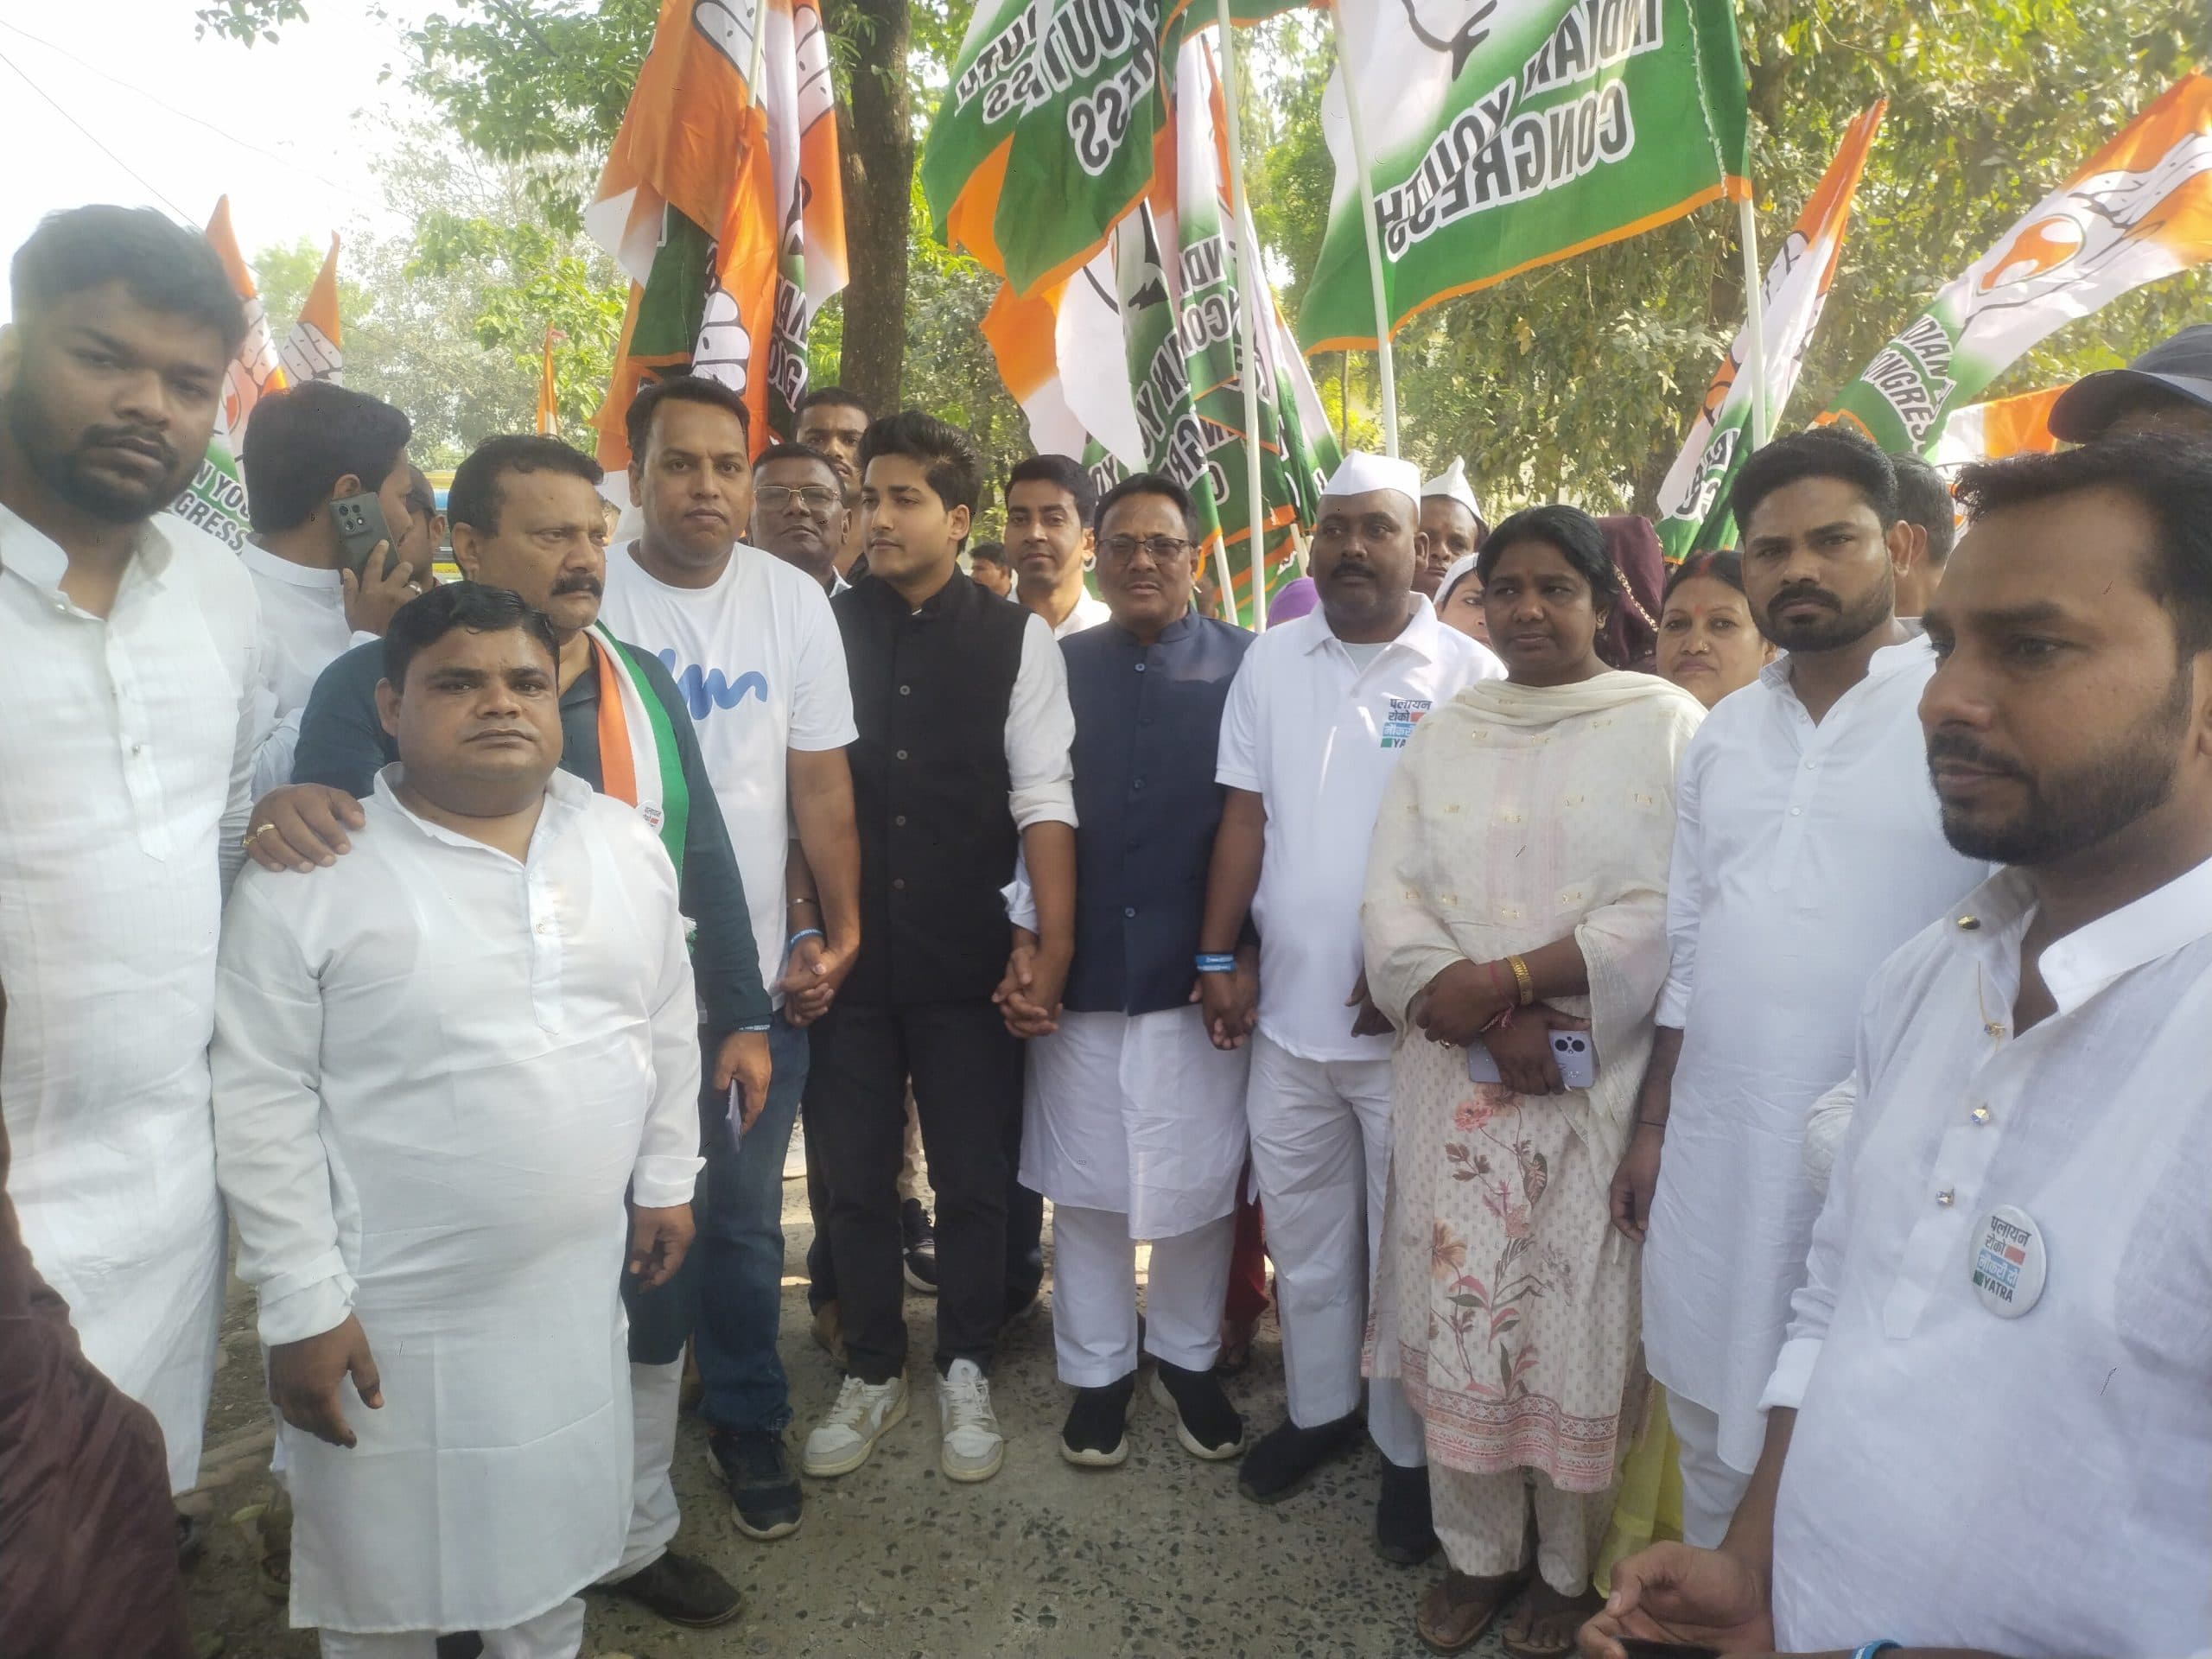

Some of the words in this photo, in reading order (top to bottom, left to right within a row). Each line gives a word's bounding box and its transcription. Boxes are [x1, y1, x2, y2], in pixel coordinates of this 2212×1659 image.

[1897, 316, 1953, 378] DIAN
[172, 491, 250, 552] GRESS
[1388, 709, 1410, 721] रोको
[1389, 698, 1433, 710] पलायन
[1990, 1215, 2032, 1247] पलायन
[1983, 1274, 2014, 1304] YATRA
